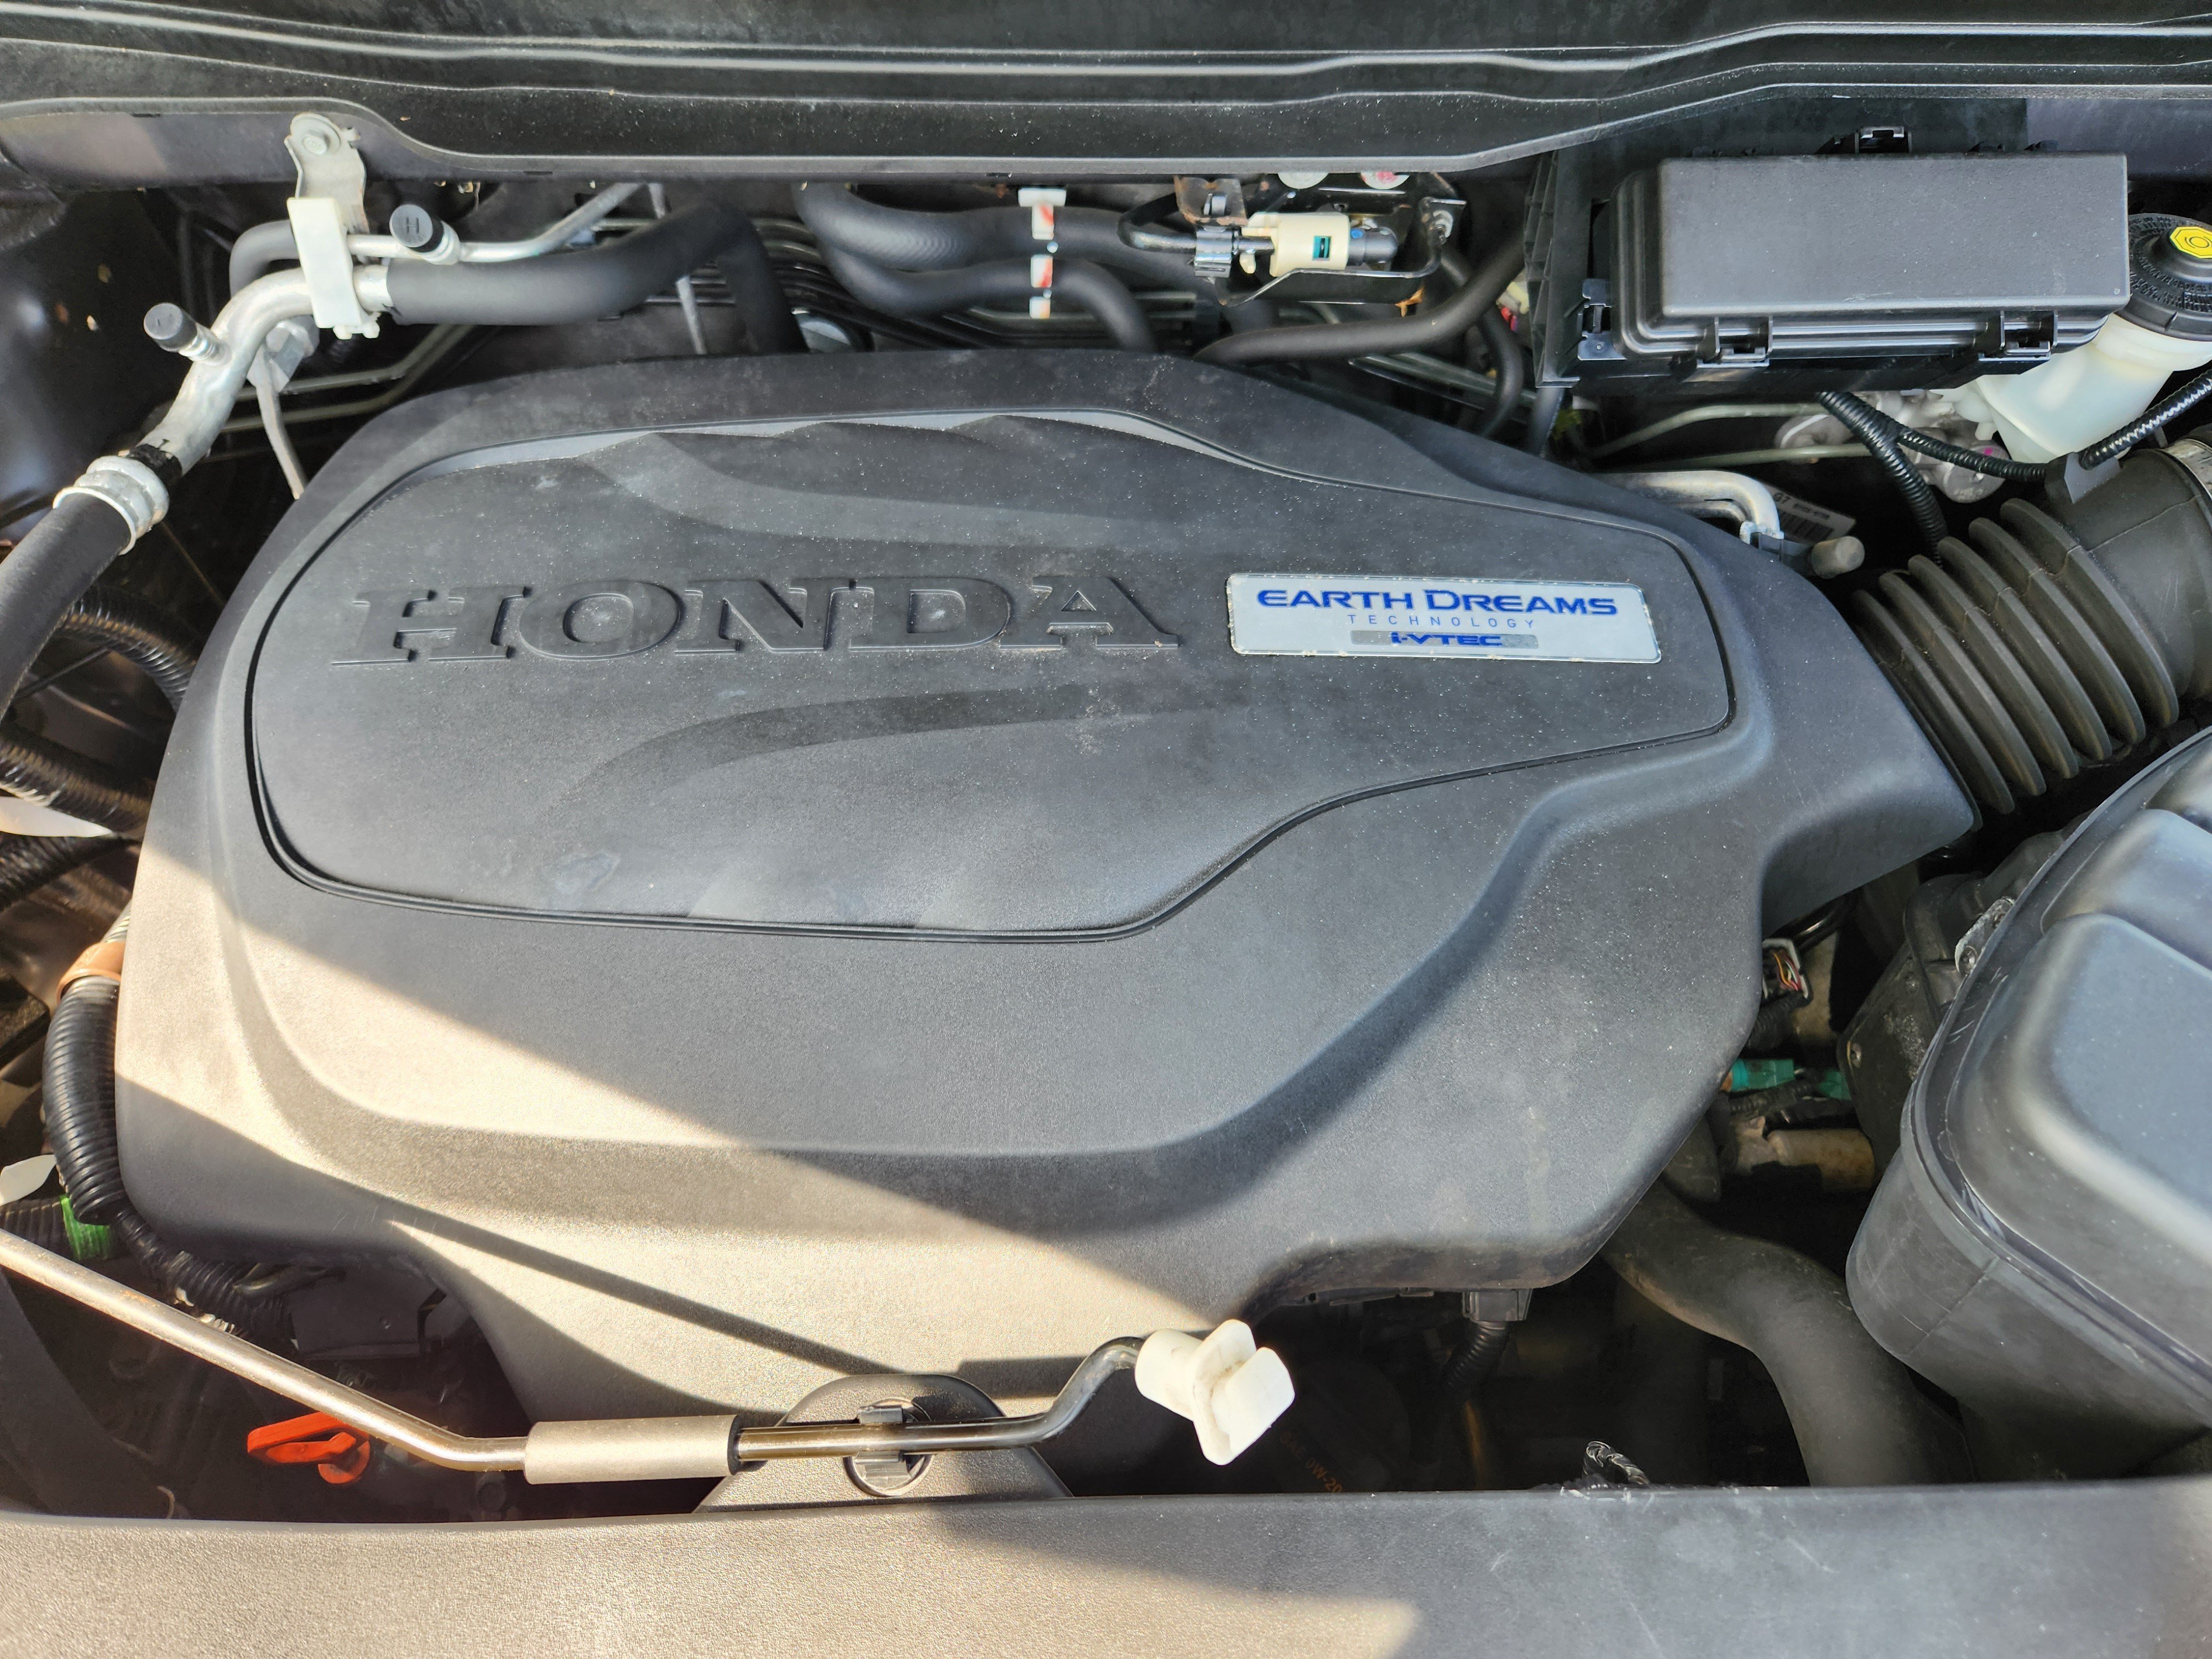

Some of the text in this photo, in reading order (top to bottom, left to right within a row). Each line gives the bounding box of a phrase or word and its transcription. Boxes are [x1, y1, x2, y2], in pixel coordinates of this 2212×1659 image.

[406, 217, 420, 234] H
[1257, 589, 1618, 615] EARTH DREAMS
[332, 576, 1181, 665] HONDA
[1348, 614, 1535, 628] TECHNOLOGY
[1391, 632, 1503, 646] i-VTEC
